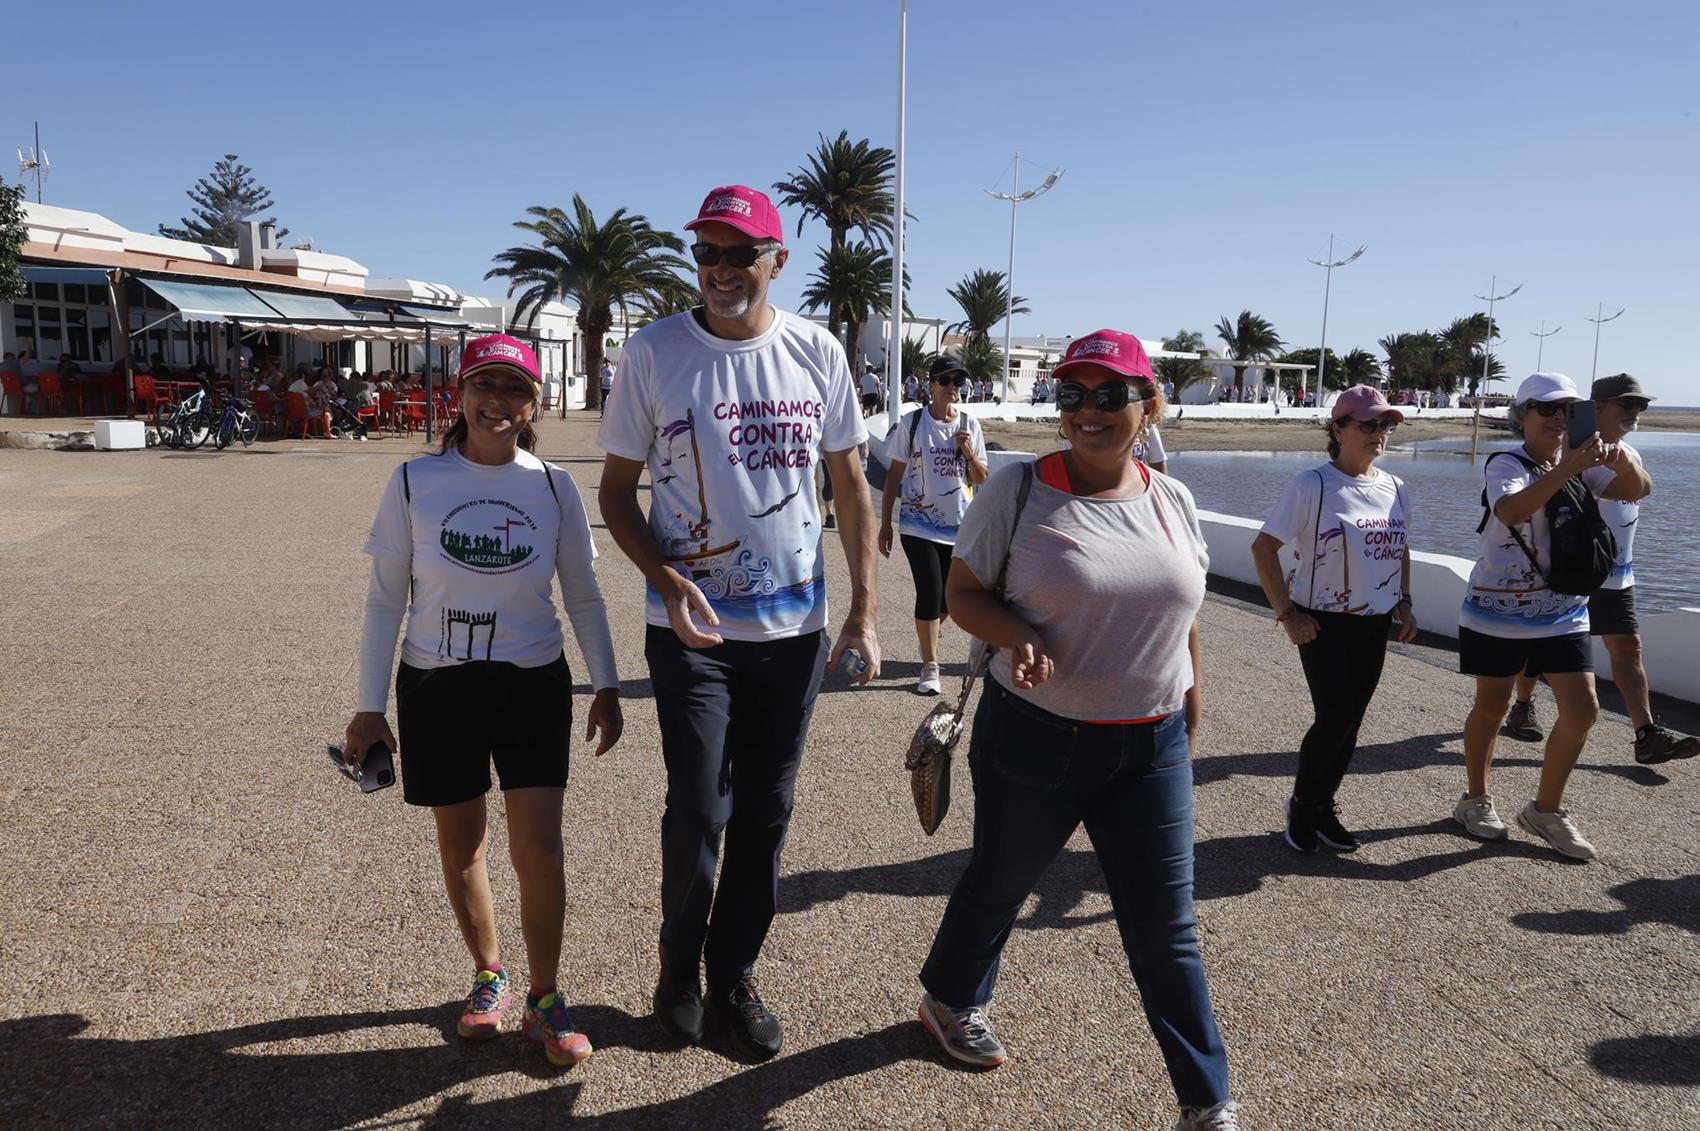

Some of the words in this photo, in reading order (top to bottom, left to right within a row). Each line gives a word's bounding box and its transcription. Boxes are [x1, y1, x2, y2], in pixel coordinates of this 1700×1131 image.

[714, 400, 822, 420] CAMINAMOS
[729, 422, 813, 446] CONTRA
[727, 452, 744, 466] EL
[935, 457, 965, 467] CONTR
[1365, 531, 1406, 545] CONTR
[464, 554, 512, 565] LANZAROTE
